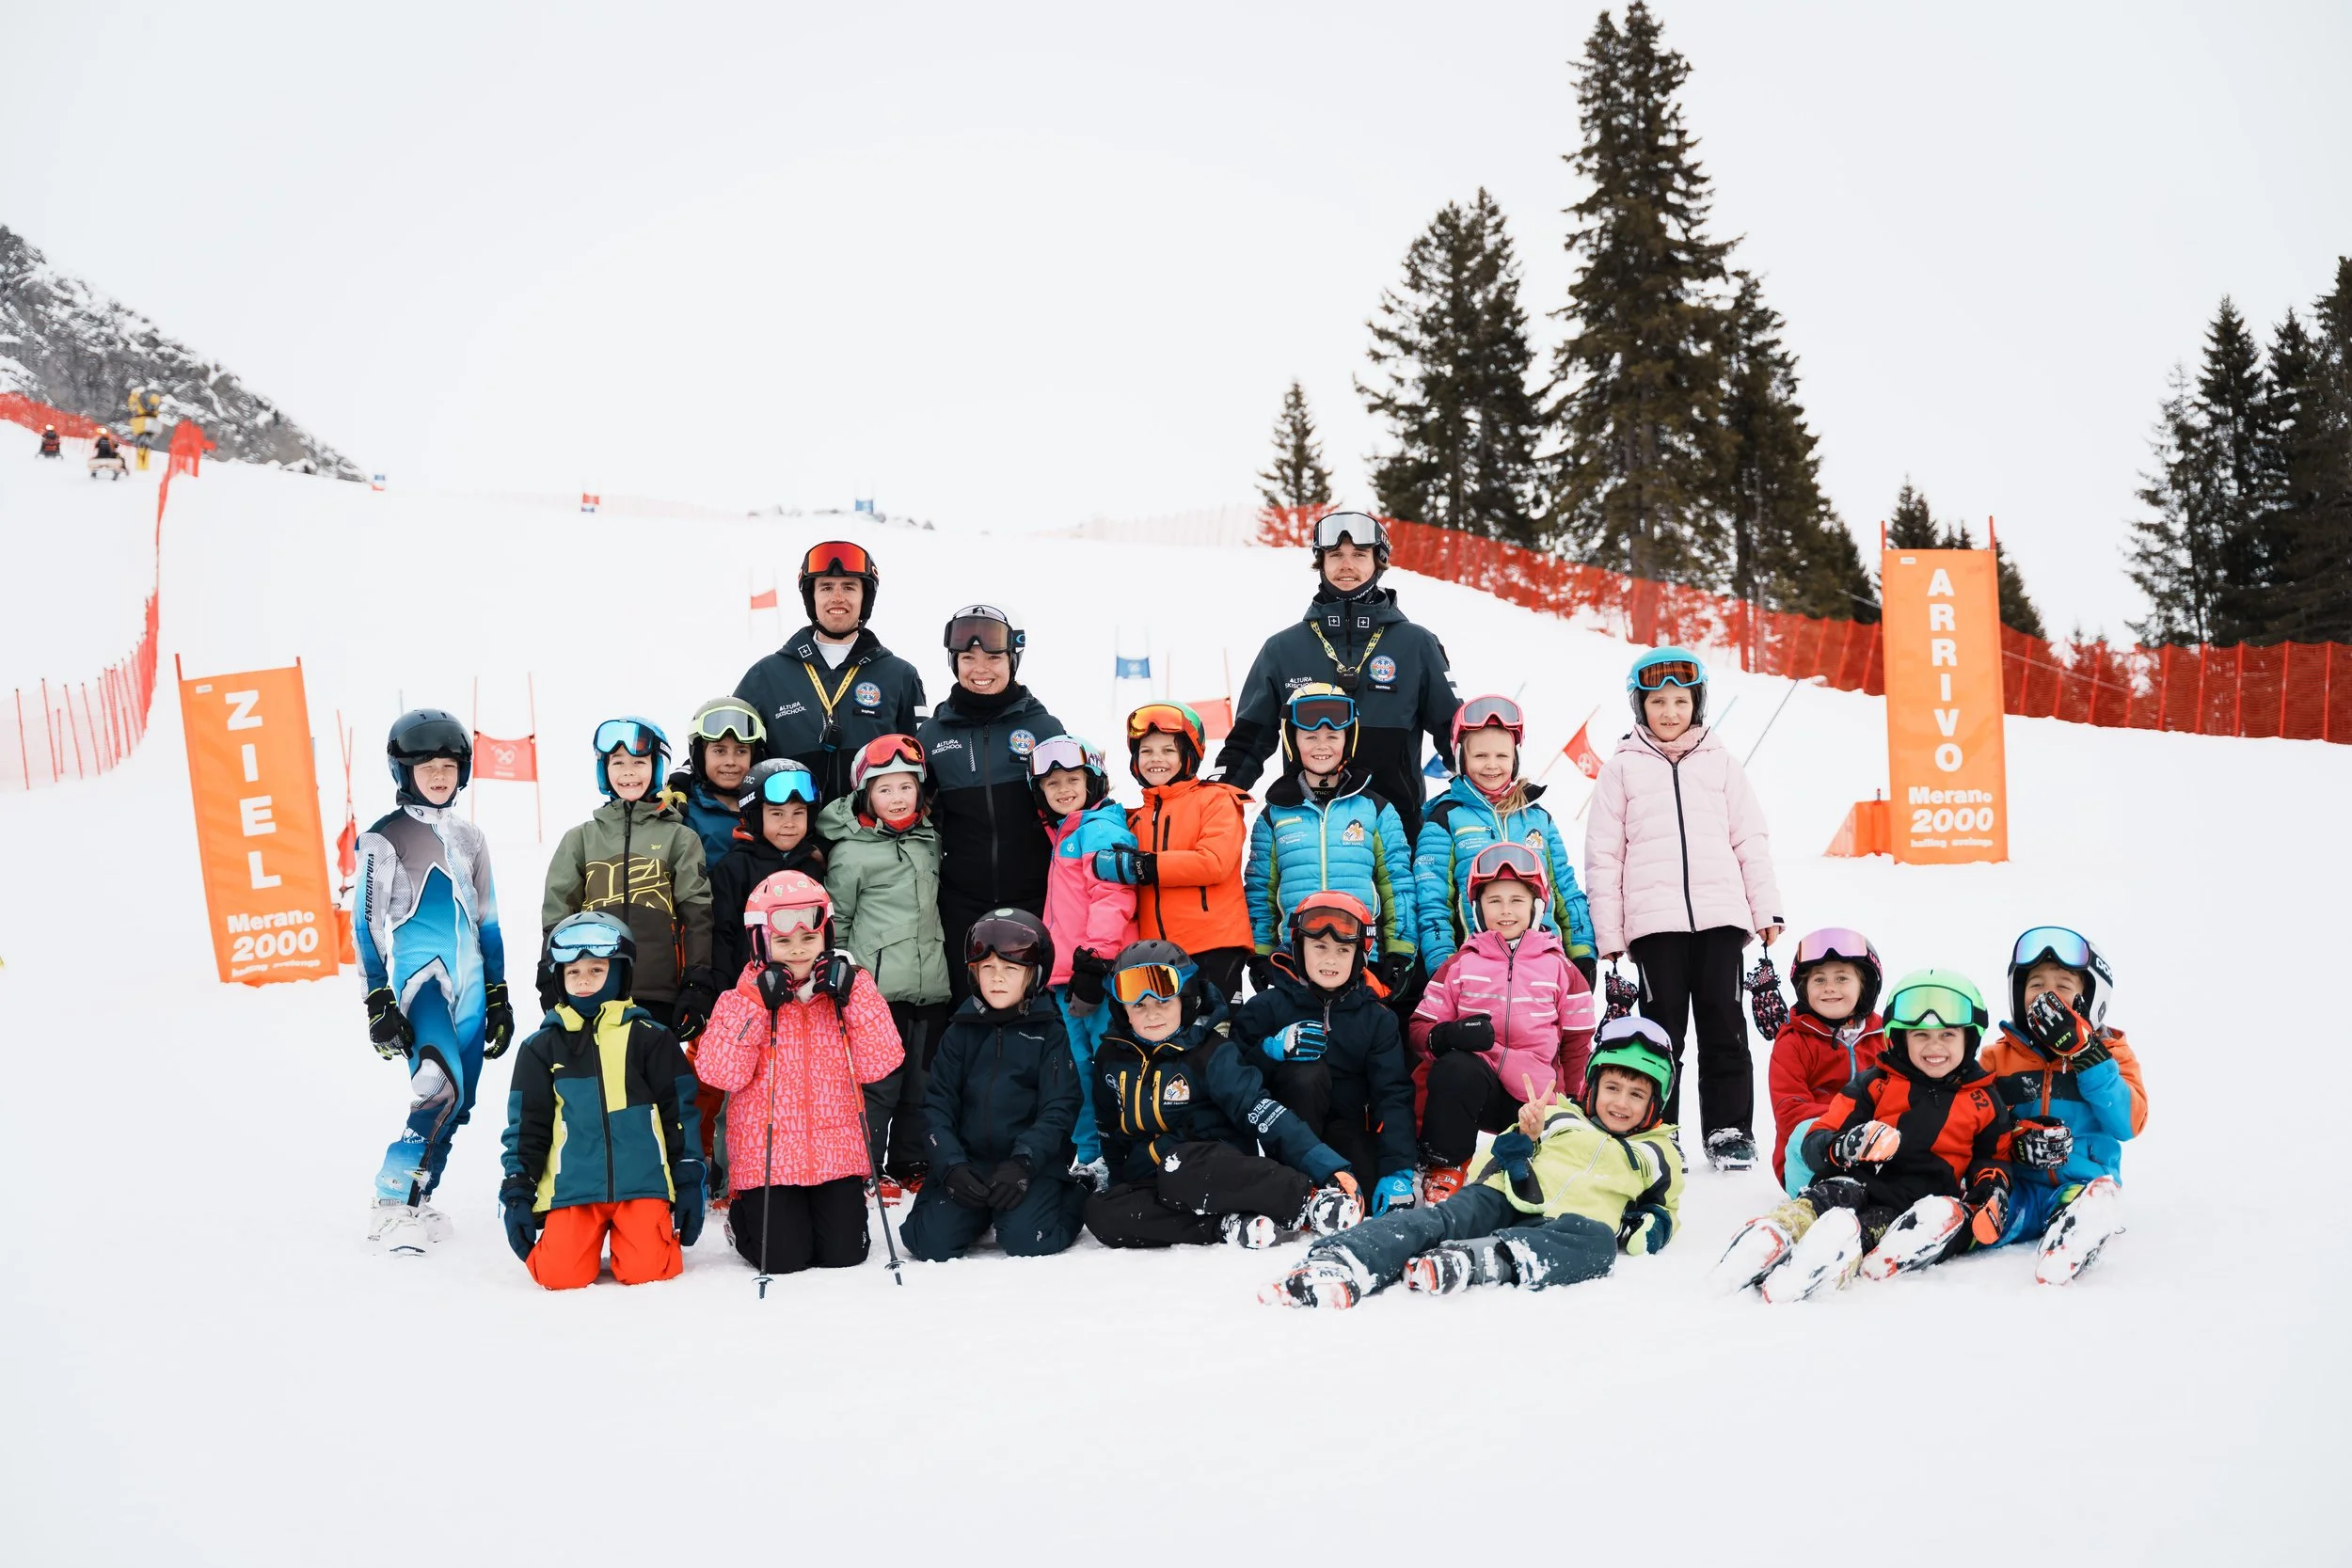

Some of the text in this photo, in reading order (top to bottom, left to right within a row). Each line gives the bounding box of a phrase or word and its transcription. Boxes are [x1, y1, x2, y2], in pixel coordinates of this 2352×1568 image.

[1927, 568, 1963, 772] ARRIVO
[775, 705, 807, 720] SKISCHOOL
[779, 701, 802, 711] ALTURA
[931, 743, 962, 755] SKISCHOOL
[936, 738, 959, 749] ALTURA
[225, 689, 282, 890] ZIEL
[1908, 785, 1993, 805] Merano
[1910, 807, 1994, 833] 2000
[364, 853, 374, 923] ENERGIAPURA
[227, 910, 315, 934] Merano
[230, 927, 319, 962] 2000
[2055, 1031, 2072, 1048] LEKI
[1970, 1089, 1990, 1111] 52
